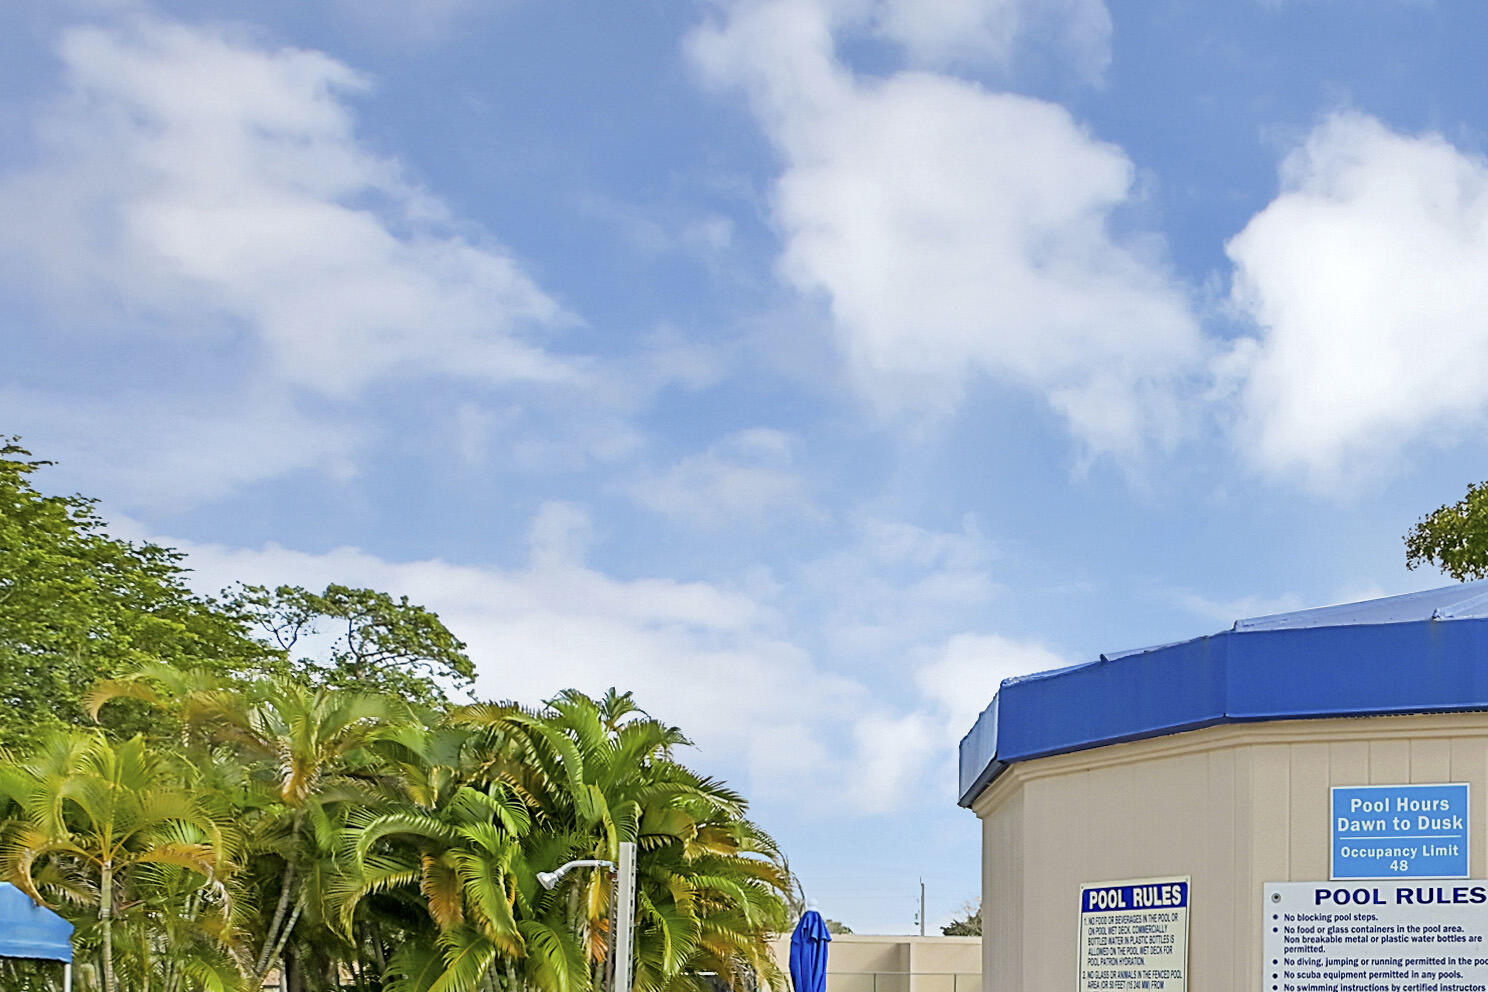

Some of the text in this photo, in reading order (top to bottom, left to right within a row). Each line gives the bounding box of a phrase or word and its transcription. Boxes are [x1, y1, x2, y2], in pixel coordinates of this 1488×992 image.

[1351, 797, 1450, 813] Pool Hours
[1338, 815, 1463, 831] Dawn to Dusk
[1341, 844, 1459, 859] Occupancy Limit
[1390, 860, 1408, 871] 48
[1089, 885, 1182, 909] POOL RULES
[1315, 887, 1487, 905] POOL RULES
[1283, 913, 1378, 923] No blocking pool steps.
[1283, 926, 1295, 934] No
[1296, 926, 1315, 934] food
[1327, 926, 1348, 935] glass
[1350, 925, 1394, 933] containers
[1396, 925, 1404, 933] in
[1406, 925, 1420, 933] the
[1422, 925, 1441, 935] pool
[1283, 935, 1300, 943] Non
[1301, 935, 1342, 943] breakable
[1344, 935, 1368, 943] metal
[1380, 935, 1409, 945] plastic
[1410, 935, 1435, 943] water
[1436, 935, 1466, 943] bottles
[1283, 945, 1325, 955] permitted.
[1283, 958, 1295, 966] No
[1296, 958, 1323, 968] diving,
[1325, 958, 1358, 968] jumping
[1371, 958, 1403, 967] running
[1404, 957, 1446, 967] permitted
[1447, 957, 1456, 965] in
[1457, 957, 1472, 965] the
[1283, 971, 1463, 981] No scuba equipment permitted in any pools.
[1283, 984, 1295, 992] No
[1340, 984, 1389, 992] instructions
[1402, 984, 1438, 992] certified
[1439, 984, 1486, 992] instructors
